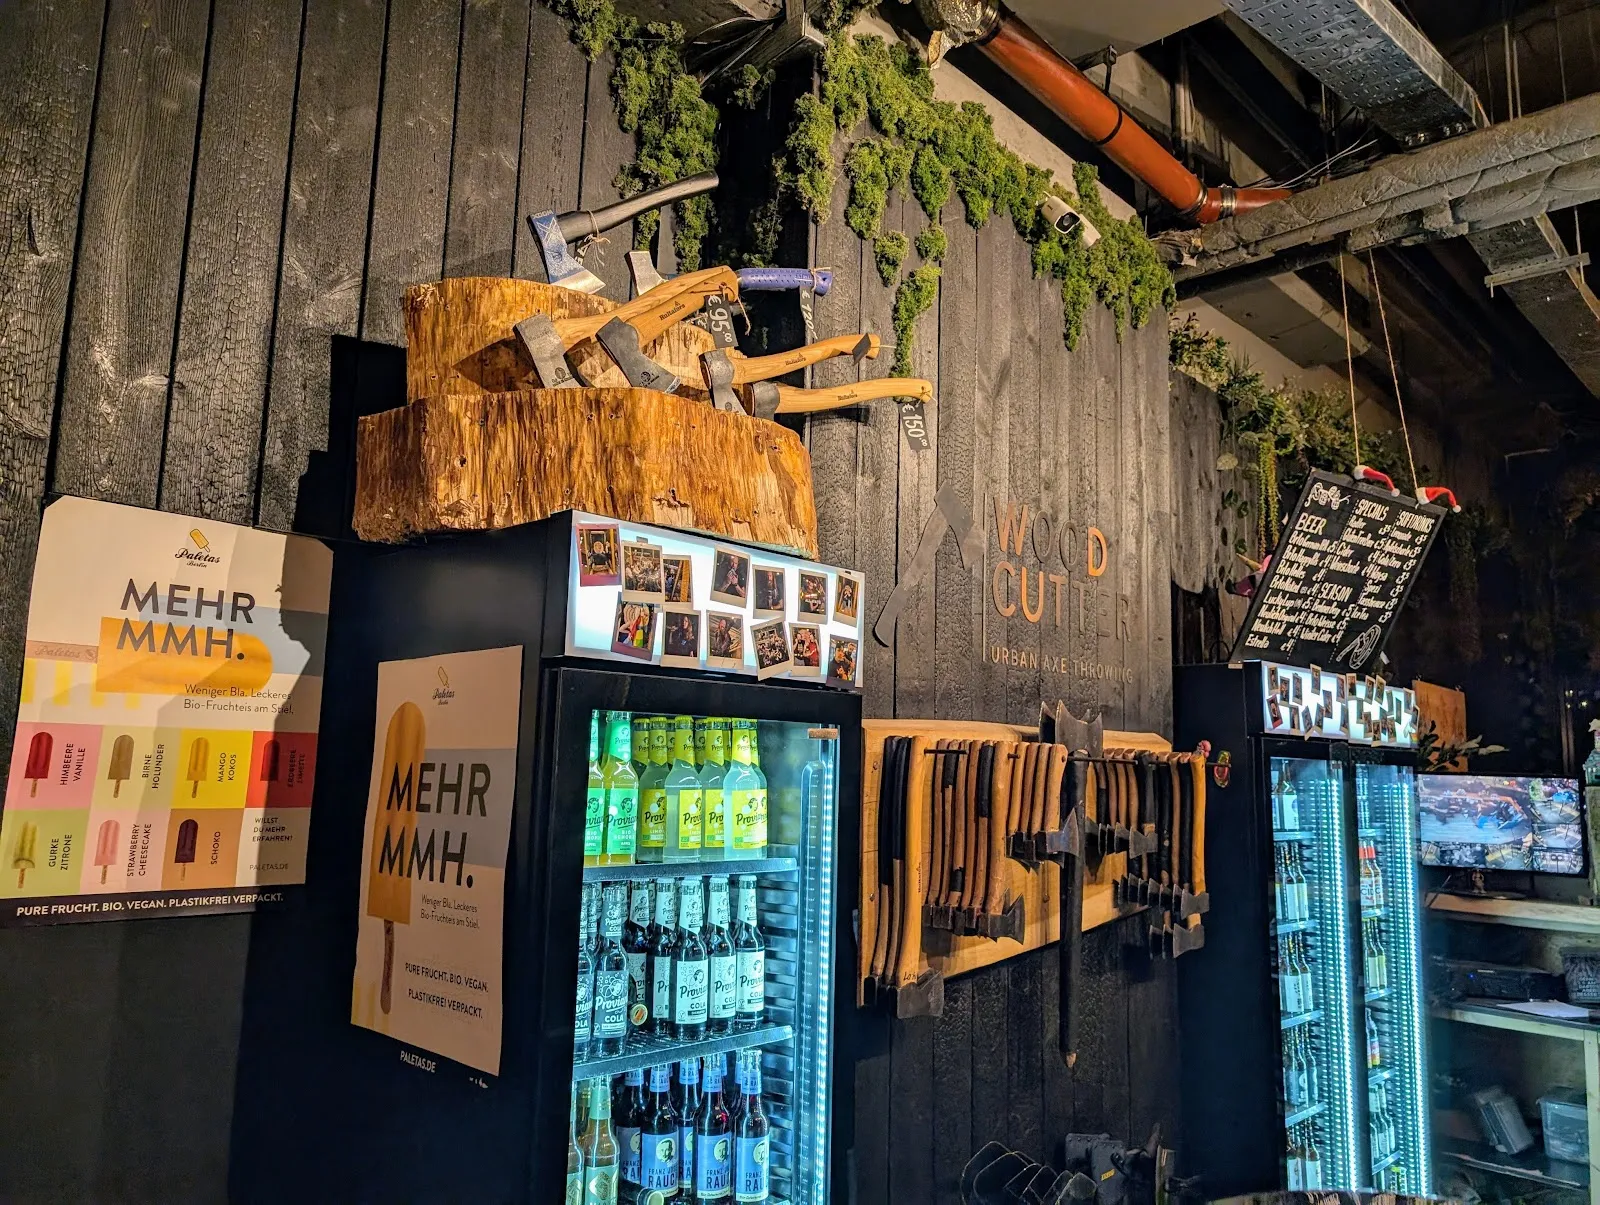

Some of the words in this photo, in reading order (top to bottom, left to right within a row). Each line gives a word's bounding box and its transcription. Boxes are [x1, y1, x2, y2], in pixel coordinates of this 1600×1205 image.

[708, 294, 722, 307] €
[902, 403, 916, 413] €
[1296, 513, 1326, 535] BEER
[1356, 500, 1389, 520] SPECIALS
[992, 496, 1108, 577] WOOD
[174, 547, 221, 564] Paletas
[186, 560, 208, 569] Berlin
[119, 577, 257, 625] MEHR
[992, 560, 1132, 643] CUTTER
[1318, 583, 1352, 601] SEASON
[115, 616, 246, 661] MMH.
[990, 645, 1038, 669] URBAN
[1042, 655, 1067, 674] AXE
[1072, 660, 1133, 684] THROWING
[184, 683, 228, 699] Weniger
[229, 686, 248, 698] Bla.
[250, 688, 292, 700] Leckeres
[183, 698, 252, 713] Bio-Fruchteis
[254, 703, 269, 713] am
[271, 703, 294, 716] Stiel.
[59, 743, 74, 787] HIMBEERE
[73, 747, 86, 782] VANILLE
[141, 753, 152, 779] BIRNE
[151, 743, 165, 790] HOLUNDER
[217, 752, 228, 783] MANGO
[227, 753, 238, 782] KOKOS
[386, 761, 492, 818] MEHR
[254, 817, 279, 825] WILLST
[48, 838, 60, 868] GURKE
[60, 834, 73, 871] ZITRONE
[126, 823, 140, 878] STRAWBERRY
[138, 823, 152, 877] CHEESECAKE
[210, 830, 221, 866] SCHOKO
[378, 824, 474, 889] MMH.
[16, 904, 49, 917] PURE
[51, 902, 101, 916] FRUCHT.
[102, 901, 126, 913] BIO.
[126, 898, 168, 911] VEGAN.
[168, 895, 232, 908] PLASTIKFREI
[232, 892, 285, 905] VERPACKT.
[421, 894, 442, 908] Weniger
[453, 900, 478, 914] Leckeres
[420, 908, 456, 926] Bio-Fruchteis
[455, 918, 465, 927] am
[465, 916, 480, 930] Stiel.
[405, 962, 421, 976] PURE
[421, 966, 449, 983] FRUCHT.
[449, 973, 463, 986] BIO.
[463, 976, 489, 993] VEGAN.
[408, 988, 447, 1008] PLASTIKFREI
[447, 999, 483, 1019] VERPACKT.
[604, 1015, 624, 1023] COLA
[400, 1050, 437, 1073] PALETAS.DE
[648, 1167, 666, 1175] FRANZ
